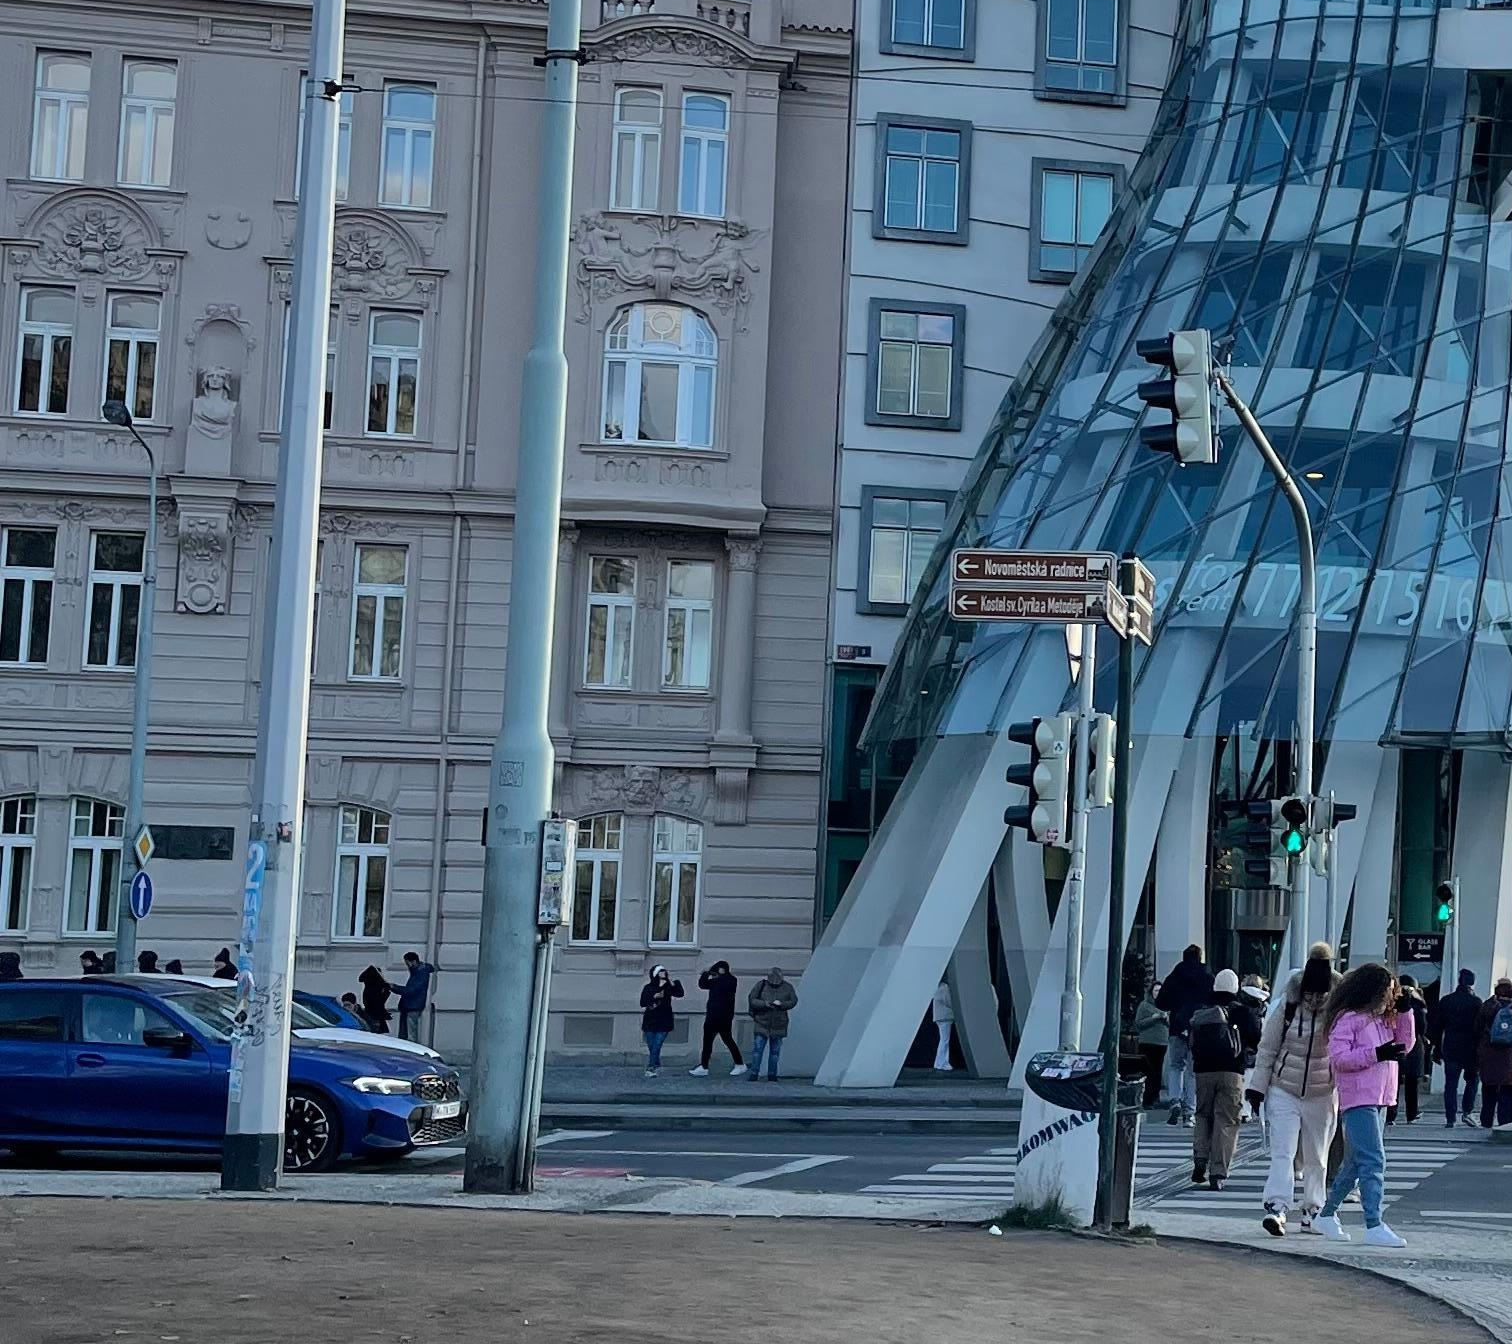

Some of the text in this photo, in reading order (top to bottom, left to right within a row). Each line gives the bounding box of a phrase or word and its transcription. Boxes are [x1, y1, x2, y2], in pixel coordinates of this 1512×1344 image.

[984, 558, 1085, 578] Novoměstská radnice
[980, 594, 1084, 617] Kostel sv. Cyrila a Metoděje
